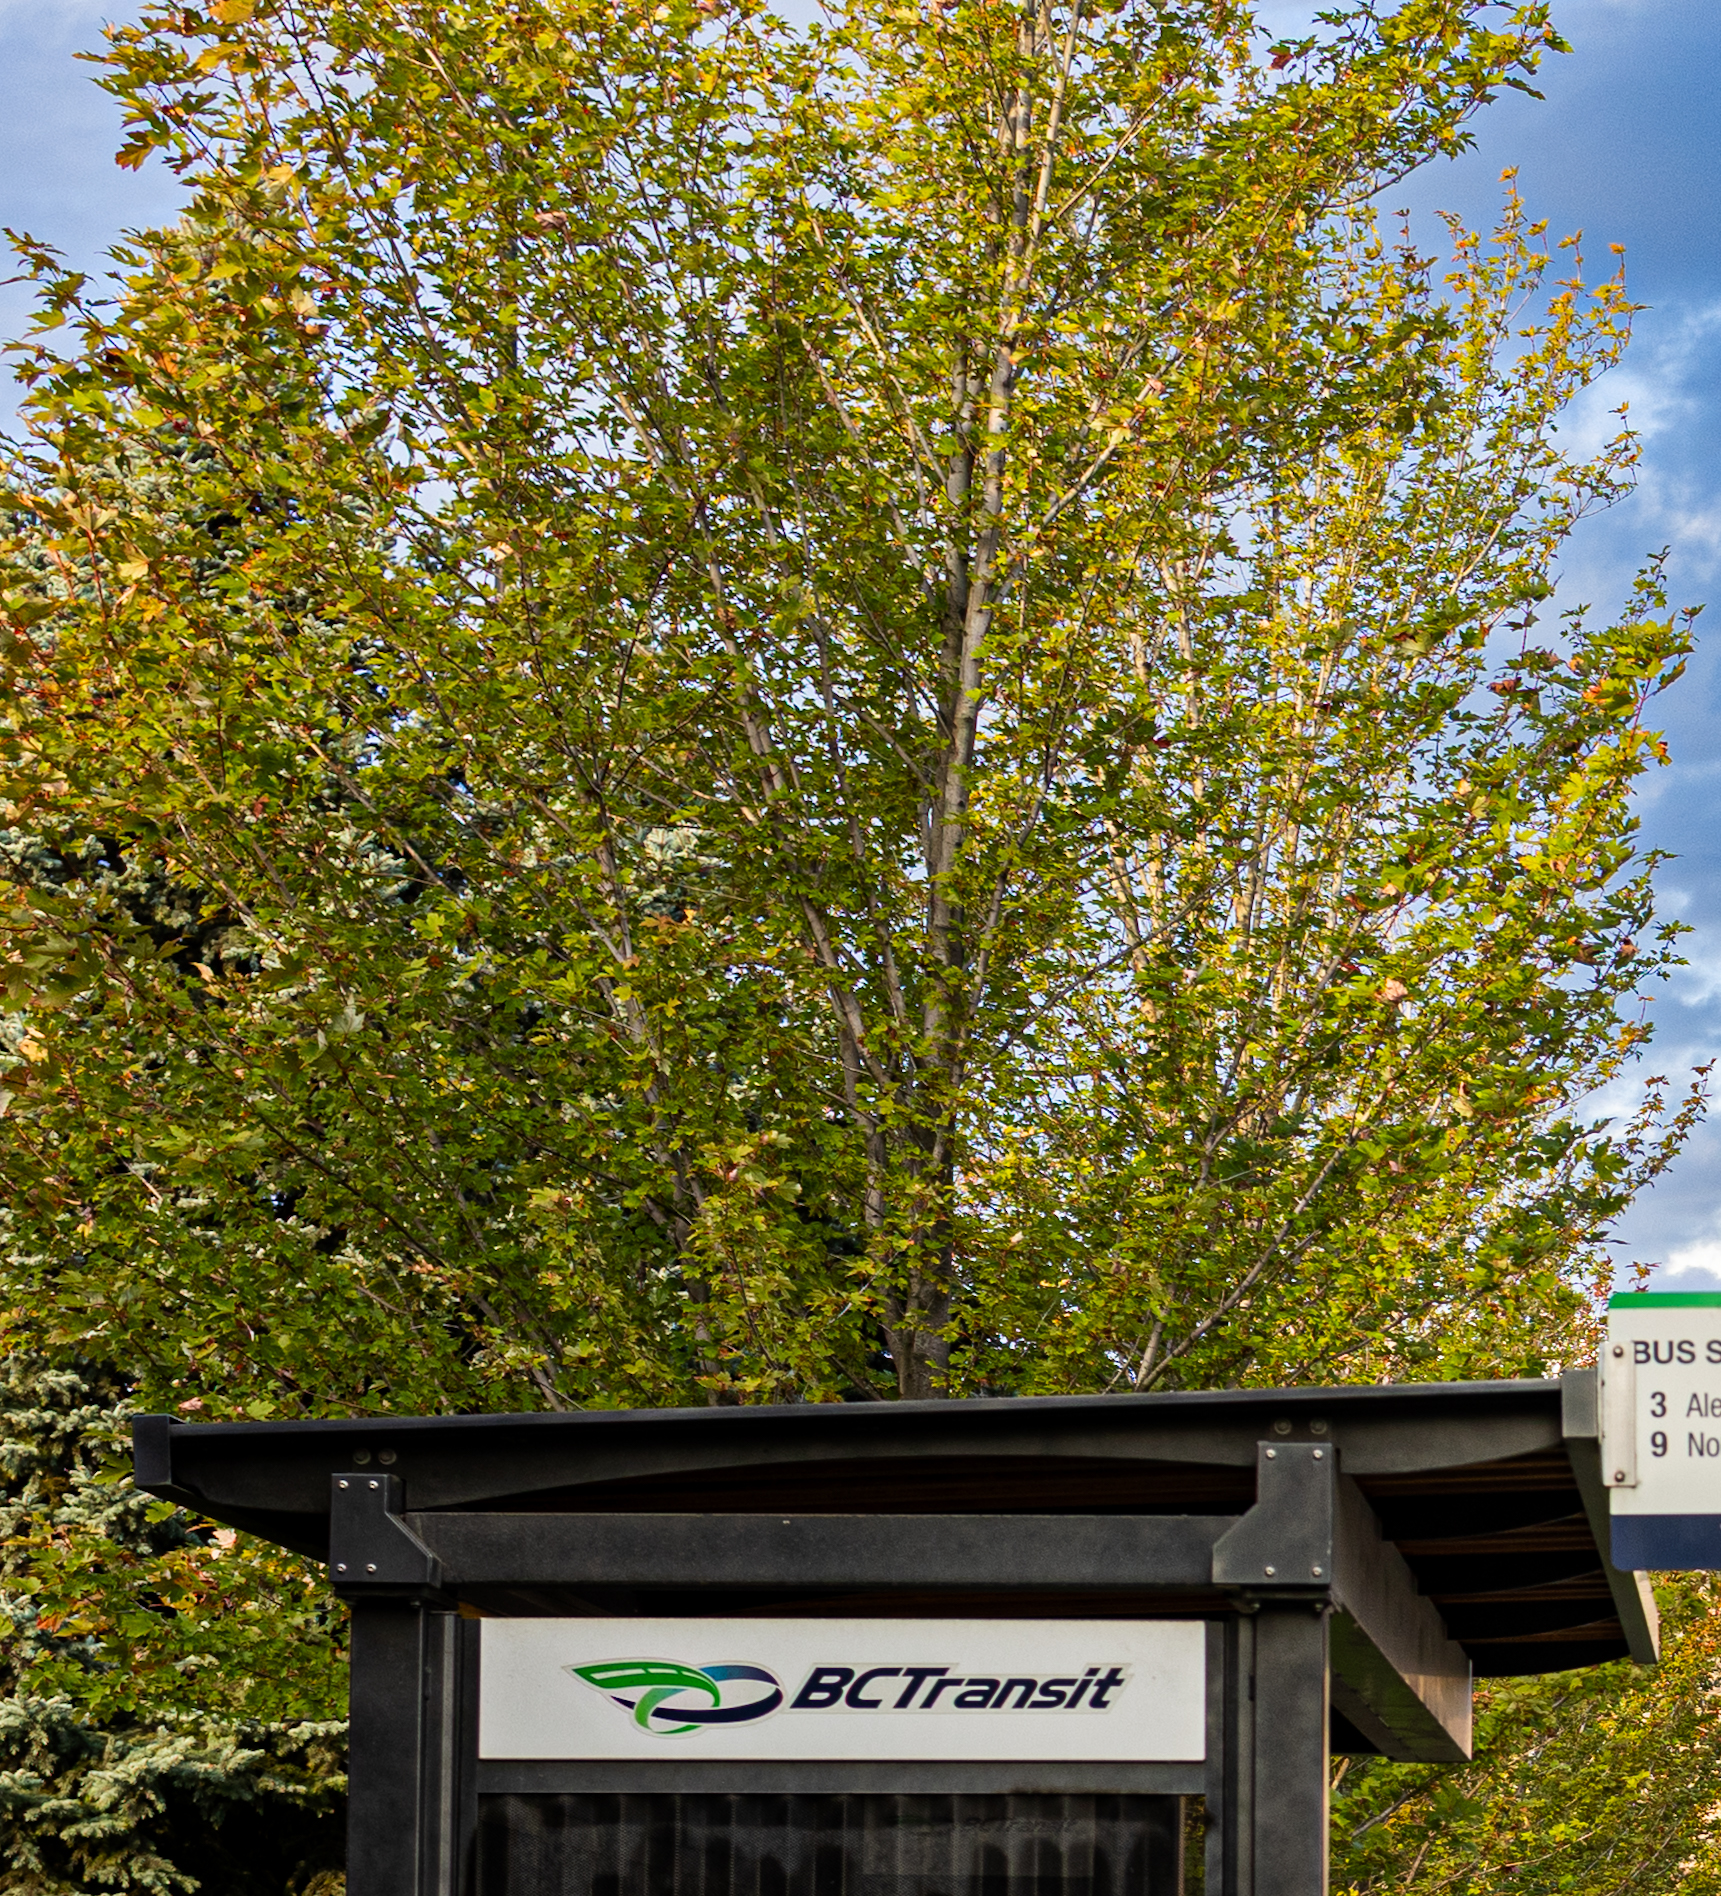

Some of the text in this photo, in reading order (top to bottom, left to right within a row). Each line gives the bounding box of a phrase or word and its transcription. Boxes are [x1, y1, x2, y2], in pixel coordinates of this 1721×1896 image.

[1633, 1339, 1696, 1364] BUS
[1650, 1391, 1667, 1418] 3
[1650, 1431, 1668, 1457] 9
[790, 1666, 1127, 1710] BCTransit
